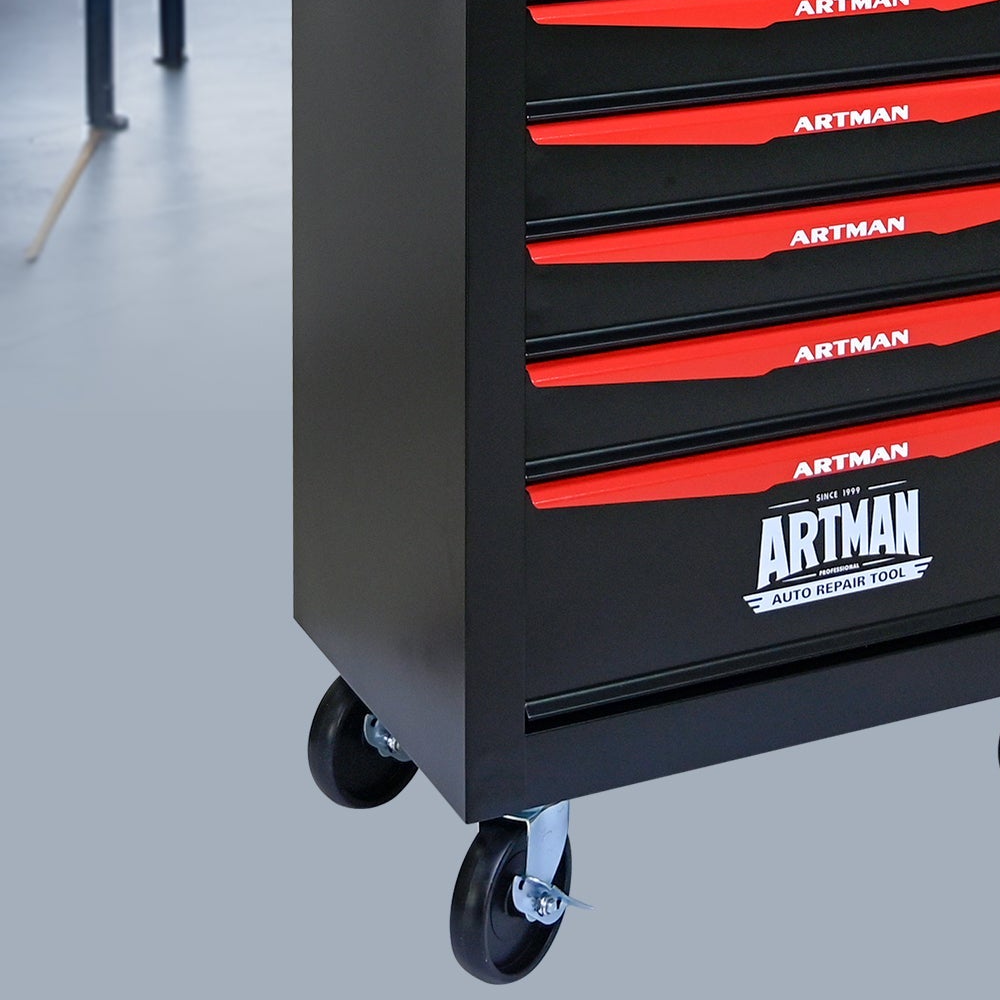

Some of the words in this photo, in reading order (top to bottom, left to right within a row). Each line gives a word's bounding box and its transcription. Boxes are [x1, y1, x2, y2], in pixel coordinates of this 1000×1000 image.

[793, 104, 909, 133] ARTMAN
[789, 215, 905, 247] ARTMAN
[793, 328, 909, 364] ARTMAN
[792, 441, 909, 480] ARTMAN
[816, 490, 838, 502] SINCE
[842, 486, 861, 497] 1999
[757, 488, 920, 590] ARTMAN
[771, 586, 812, 606] AUTO
[816, 575, 866, 596] REPAIR
[869, 566, 906, 584] TOOL
[818, 562, 860, 576] PROFESSIONAL
